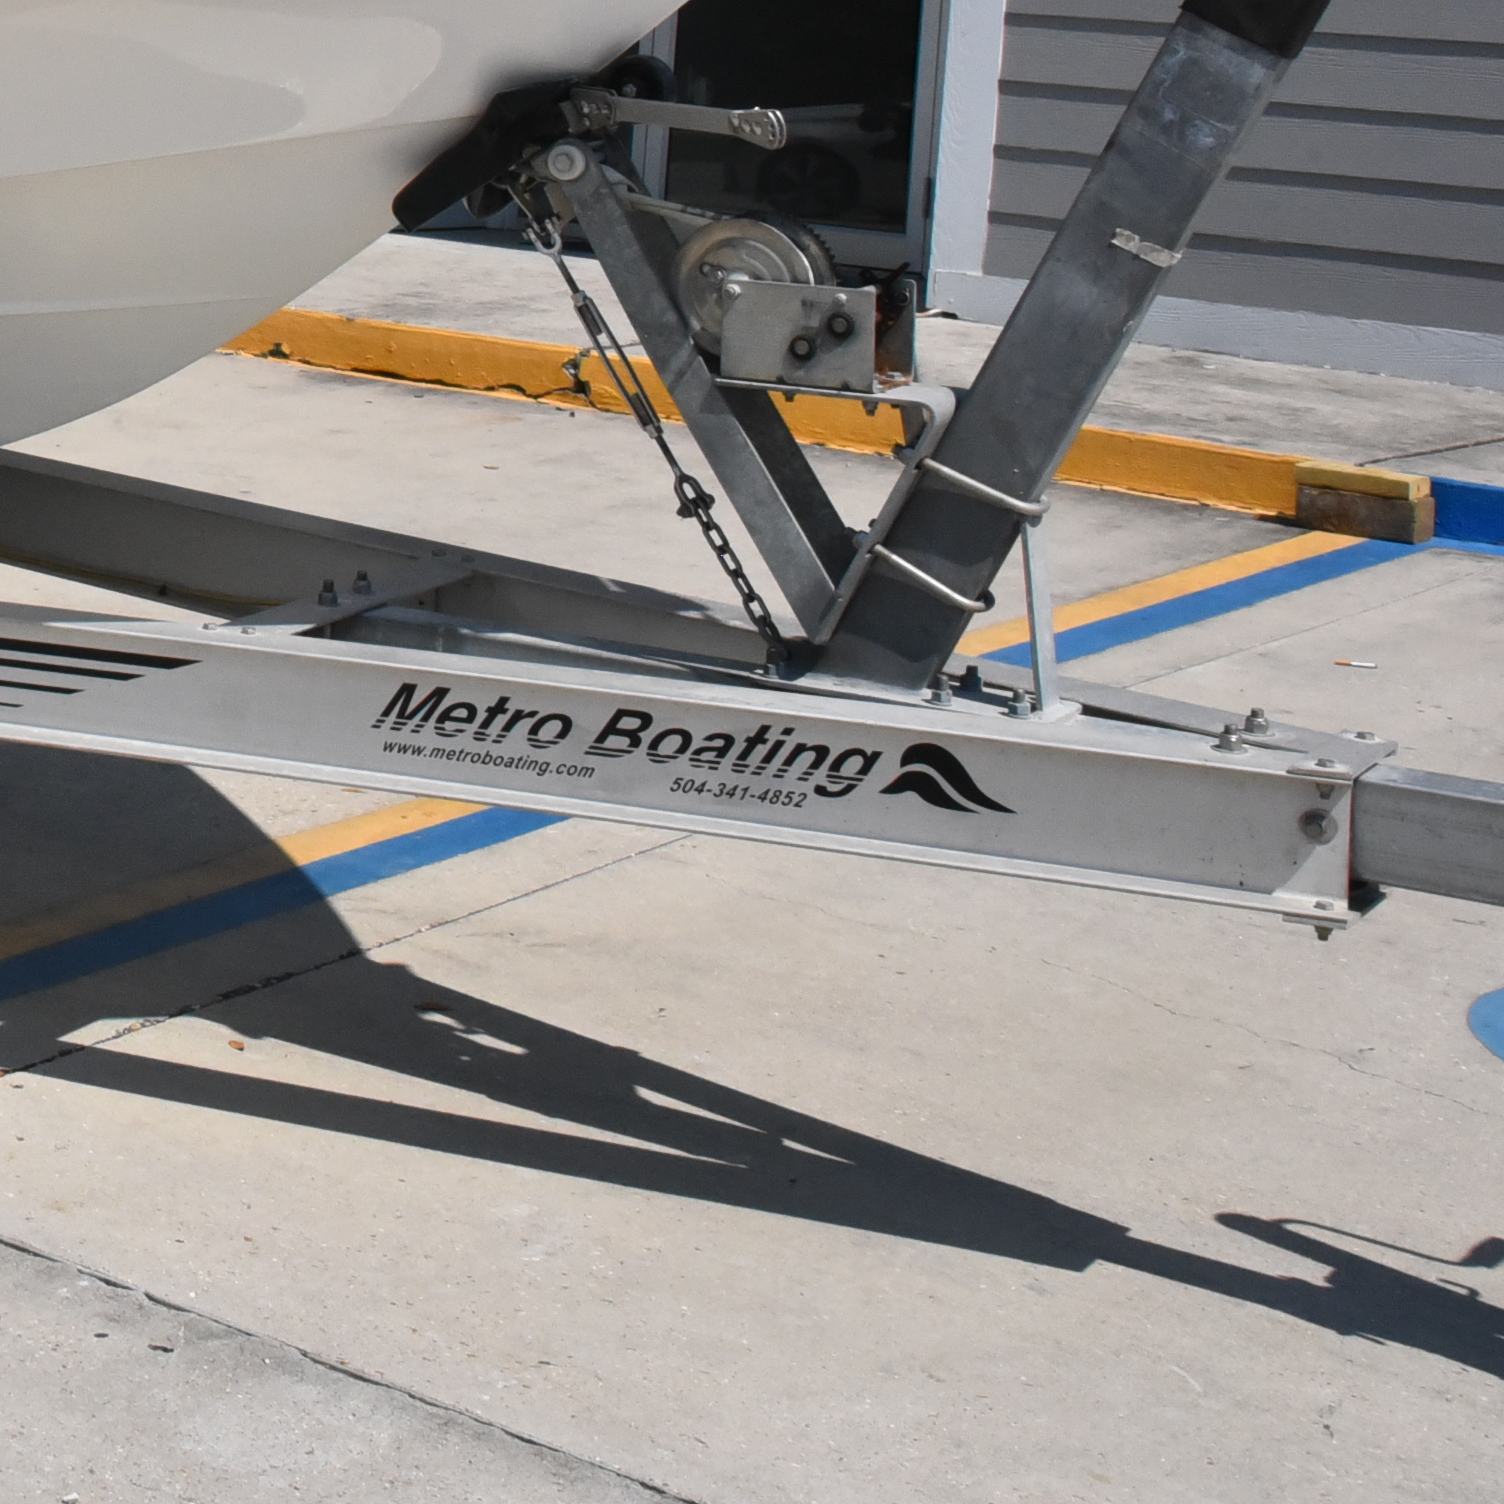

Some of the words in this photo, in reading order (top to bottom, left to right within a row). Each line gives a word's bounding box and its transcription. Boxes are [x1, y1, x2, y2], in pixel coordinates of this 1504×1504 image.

[371, 682, 574, 750] Metro
[583, 707, 884, 799] Boating
[382, 740, 596, 779] www.metroboating.com
[669, 777, 808, 808] 504-341-4852
